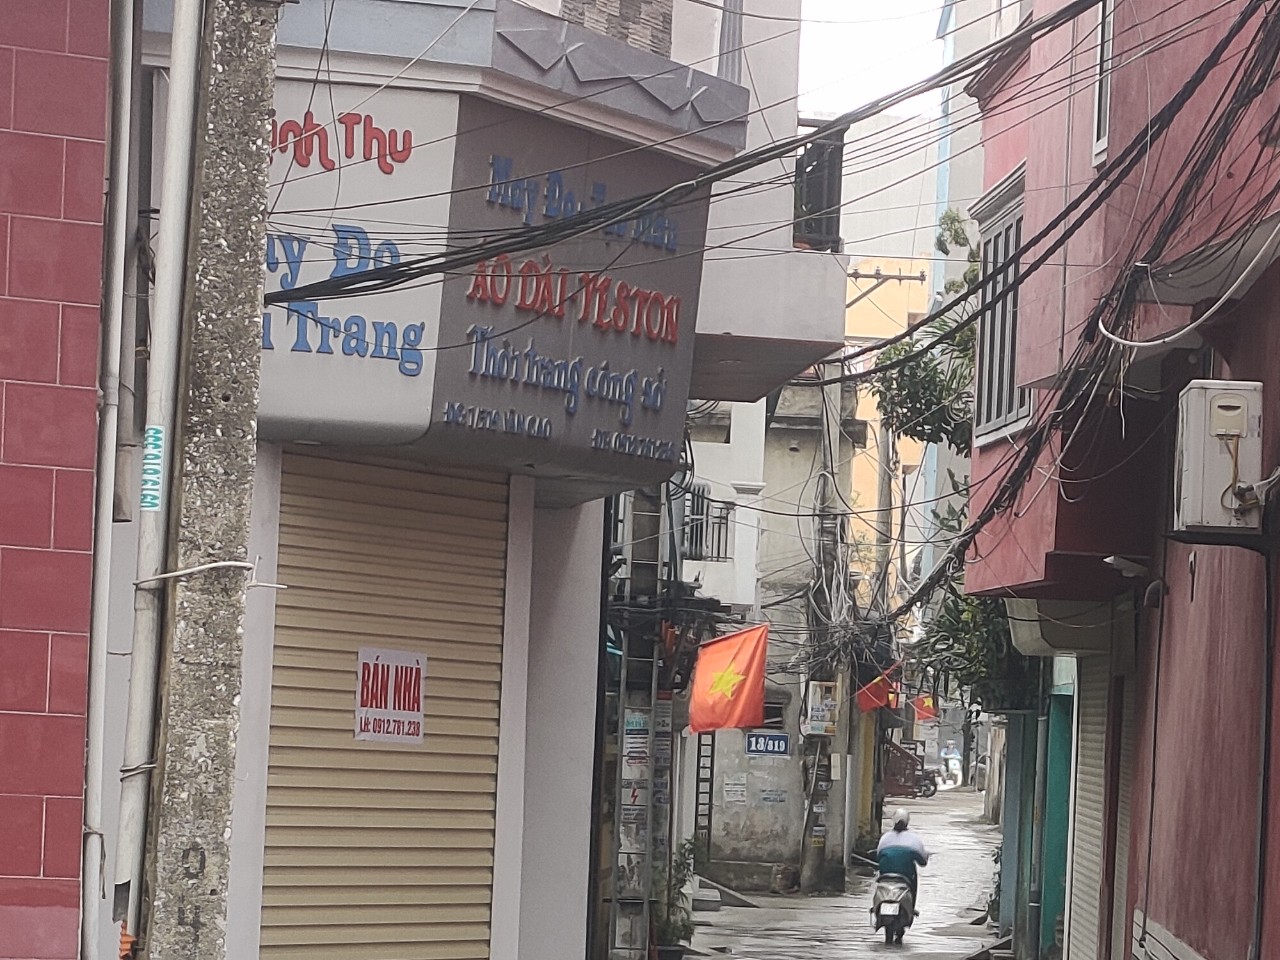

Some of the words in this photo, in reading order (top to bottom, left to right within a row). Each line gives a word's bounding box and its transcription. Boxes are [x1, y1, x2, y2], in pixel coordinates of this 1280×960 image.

[338, 112, 413, 175] Thu
[287, 301, 425, 376] Trang
[523, 337, 584, 414] trang
[585, 360, 639, 427] công
[360, 655, 390, 710] BÁN
[393, 659, 421, 712] NHÀ
